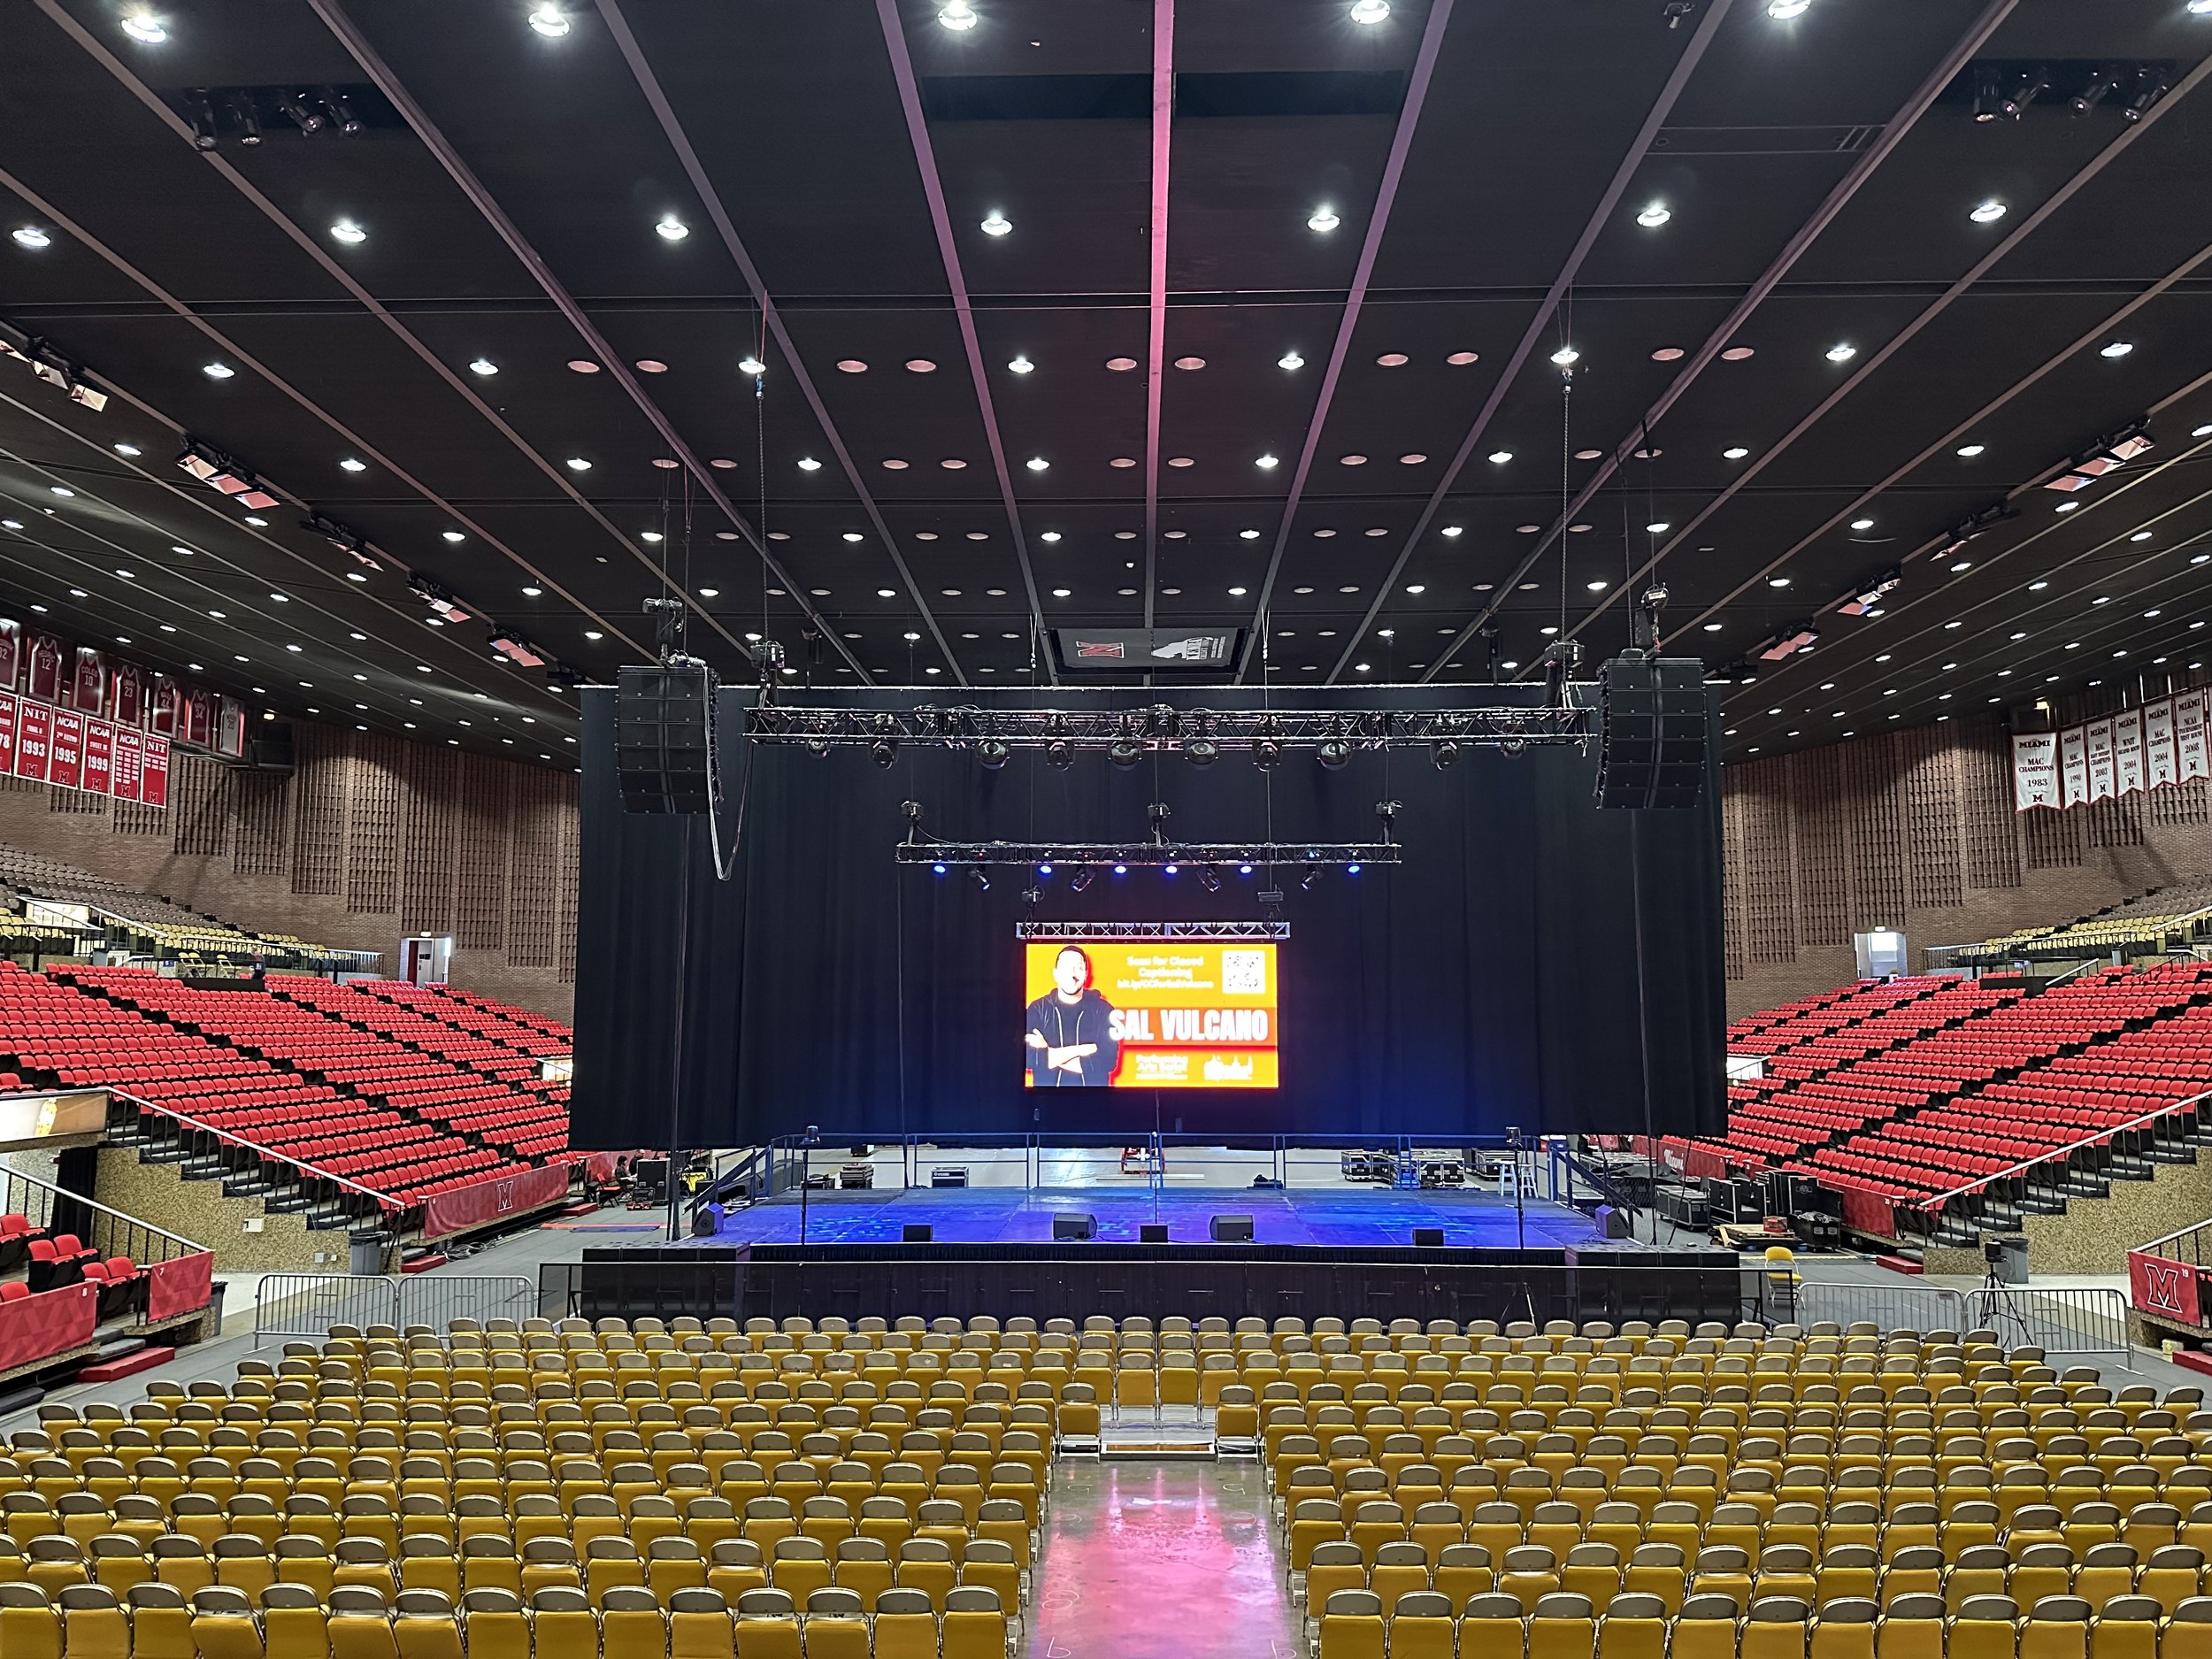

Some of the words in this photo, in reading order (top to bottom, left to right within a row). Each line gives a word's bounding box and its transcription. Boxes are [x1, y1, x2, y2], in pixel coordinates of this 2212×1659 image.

[42, 658, 51, 670] 12
[84, 674, 94, 687] 10
[124, 686, 133, 698] 23
[2178, 699, 2200, 711] MIAMI
[24, 707, 48, 721] NIT
[2148, 708, 2169, 720] MIAMI
[57, 717, 79, 730] NCAA
[2118, 718, 2138, 728] MIAMI
[89, 726, 109, 738] NCAA
[2090, 726, 2108, 737] MIAMI
[119, 734, 139, 746] NCAA
[2063, 733, 2081, 744] MIAMI
[22, 739, 45, 757] 1993
[147, 741, 166, 754] NIT
[55, 746, 76, 764] 1995
[88, 756, 108, 772] 1999
[2018, 764, 2054, 773] CHAMPIONS
[2189, 760, 2197, 771] M
[2159, 770, 2166, 779] M
[2027, 779, 2047, 787] 1983
[2128, 777, 2135, 786] M
[2032, 794, 2044, 803] M
[1109, 1009, 1154, 1041] SAL
[1160, 1009, 1268, 1041] VULCANO
[497, 1181, 513, 1212] M
[159, 1267, 165, 1277] 7
[81, 1287, 88, 1297] 8
[2144, 1263, 2183, 1314] M
[2181, 1268, 2189, 1278] 19
